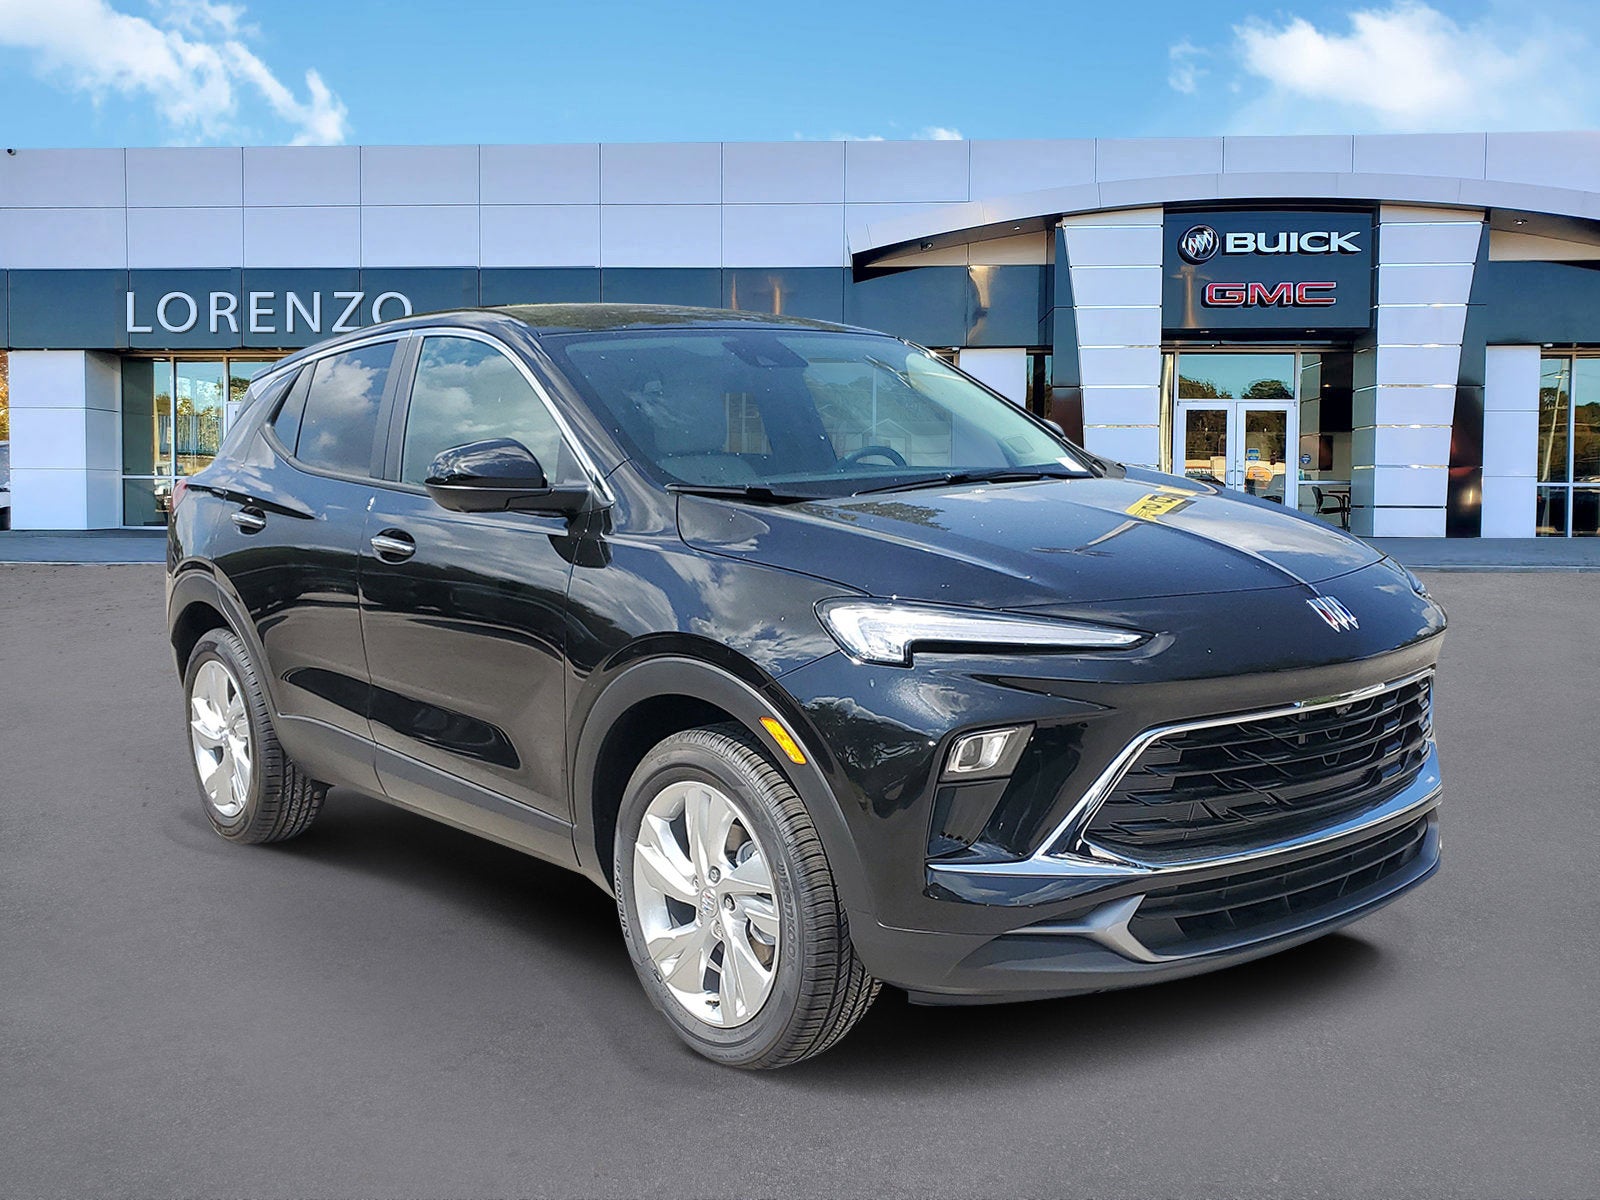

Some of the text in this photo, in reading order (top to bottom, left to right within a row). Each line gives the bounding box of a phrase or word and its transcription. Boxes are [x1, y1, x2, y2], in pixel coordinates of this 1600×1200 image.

[1225, 231, 1362, 253] BUICK
[1205, 281, 1337, 305] GMC
[126, 291, 413, 333] LORENZO
